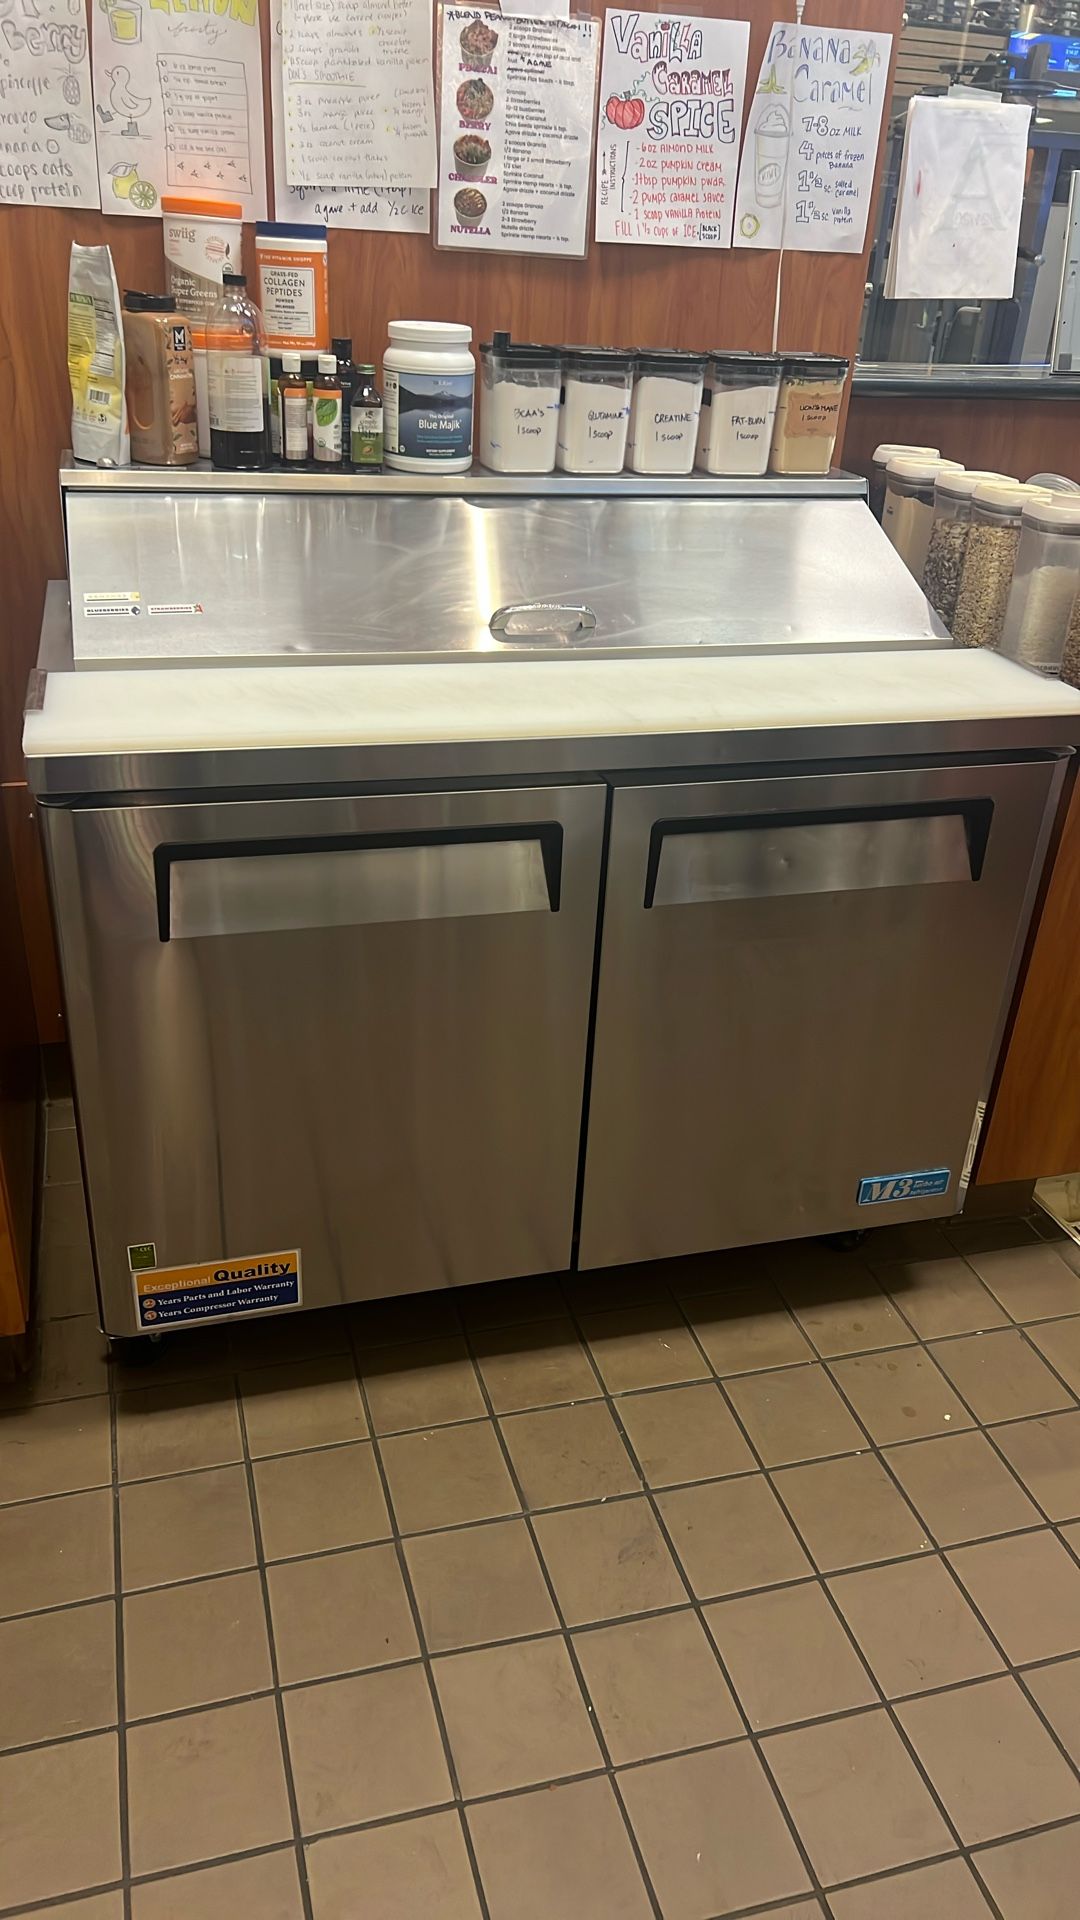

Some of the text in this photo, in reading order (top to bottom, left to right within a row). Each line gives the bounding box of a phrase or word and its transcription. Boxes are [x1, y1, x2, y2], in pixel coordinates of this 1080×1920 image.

[647, 99, 736, 144] SPICE
[843, 127, 862, 136] MILK
[696, 143, 714, 153] MILK
[799, 140, 814, 160] 4
[0, 158, 73, 180] coops oats
[32, 183, 82, 202] protein
[601, 180, 609, 206] RECIPE
[633, 191, 638, 204] 2
[360, 202, 378, 214] add
[635, 209, 639, 220] 1
[169, 228, 196, 242] swiig
[450, 225, 491, 235] NUTELLA
[615, 220, 632, 237] FILL
[170, 275, 196, 287] Organic
[264, 277, 305, 287] COLLAGEN
[190, 288, 217, 298] Greens
[267, 288, 303, 297] PEPTIDES
[654, 413, 693, 424] CREATINE
[731, 415, 766, 426] FAT-BURN
[418, 419, 460, 432] Blue Majik
[861, 1178, 913, 1203] M3
[143, 1262, 292, 1293] Exceptional Quality
[157, 1297, 182, 1306] Years
[183, 1292, 206, 1302] Parts
[208, 1290, 225, 1299] and
[226, 1286, 252, 1295] Labor
[254, 1280, 295, 1291] Warranty
[158, 1309, 182, 1318] Years
[183, 1300, 236, 1314] Compressor
[238, 1294, 279, 1306] Warranty
